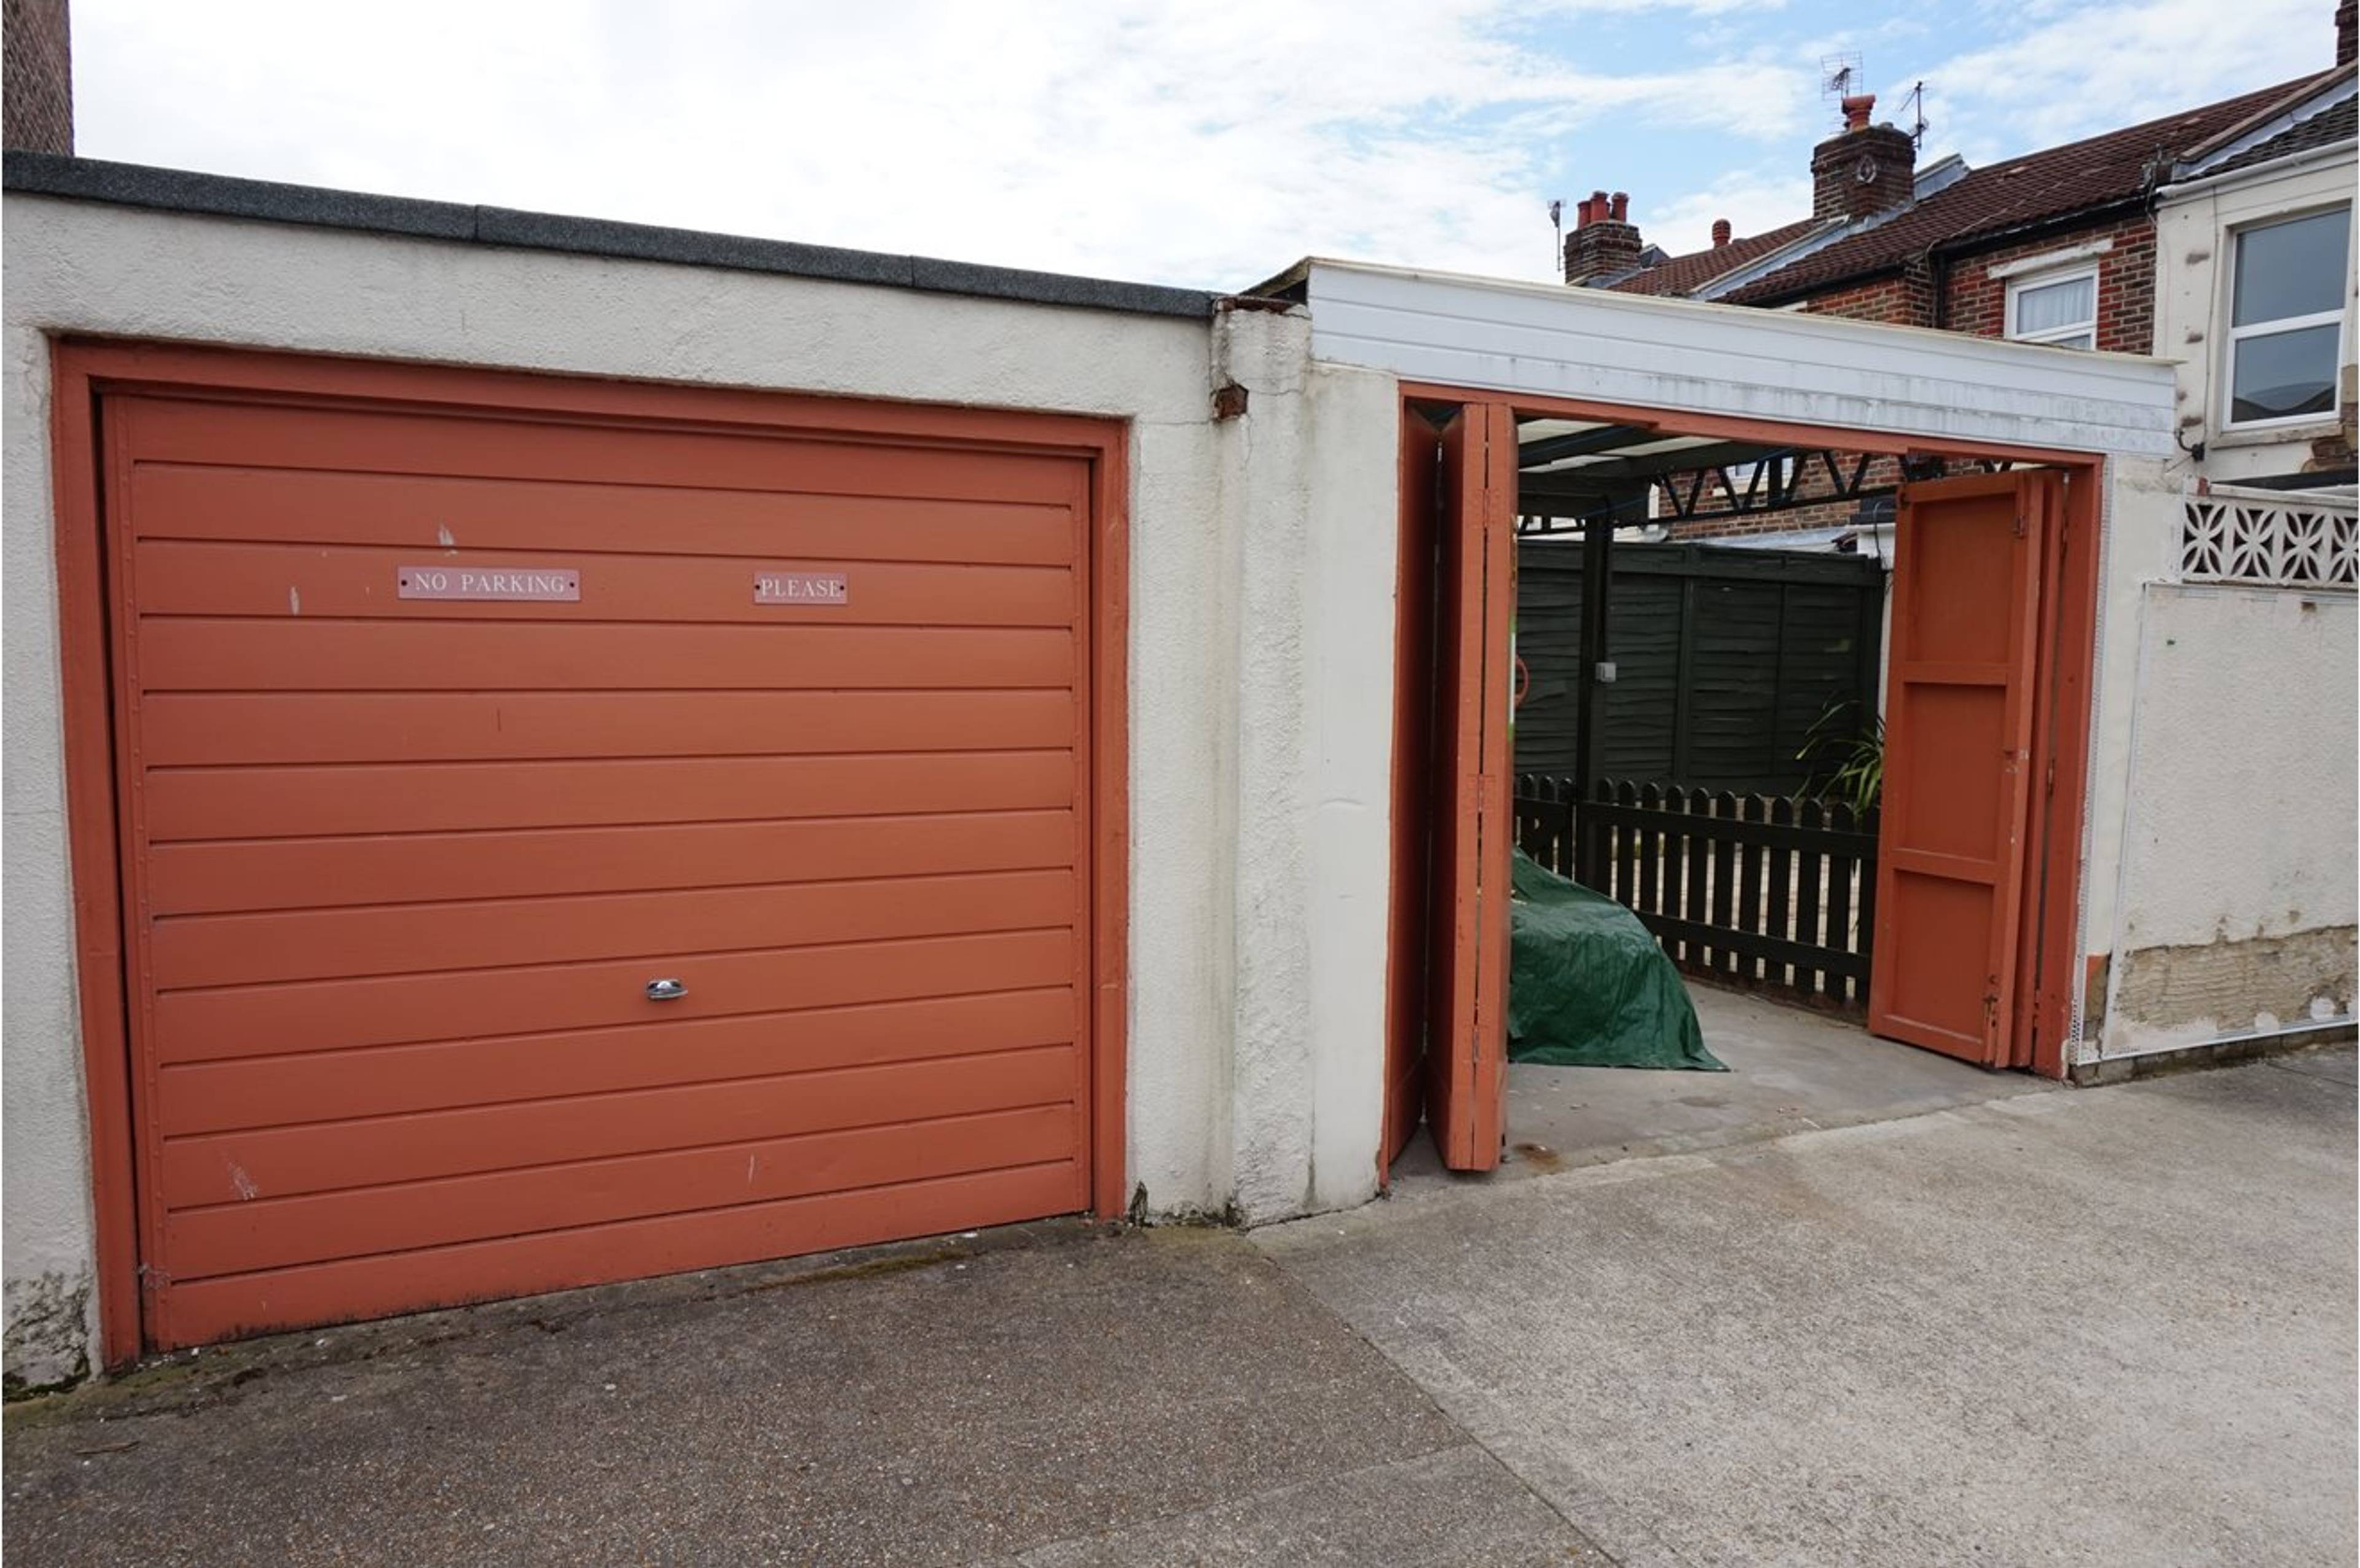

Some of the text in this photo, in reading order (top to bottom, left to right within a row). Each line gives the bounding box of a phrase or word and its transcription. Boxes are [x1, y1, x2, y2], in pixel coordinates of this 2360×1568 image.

[415, 573, 564, 592] NO PARKING
[761, 578, 841, 597] PLEASE
